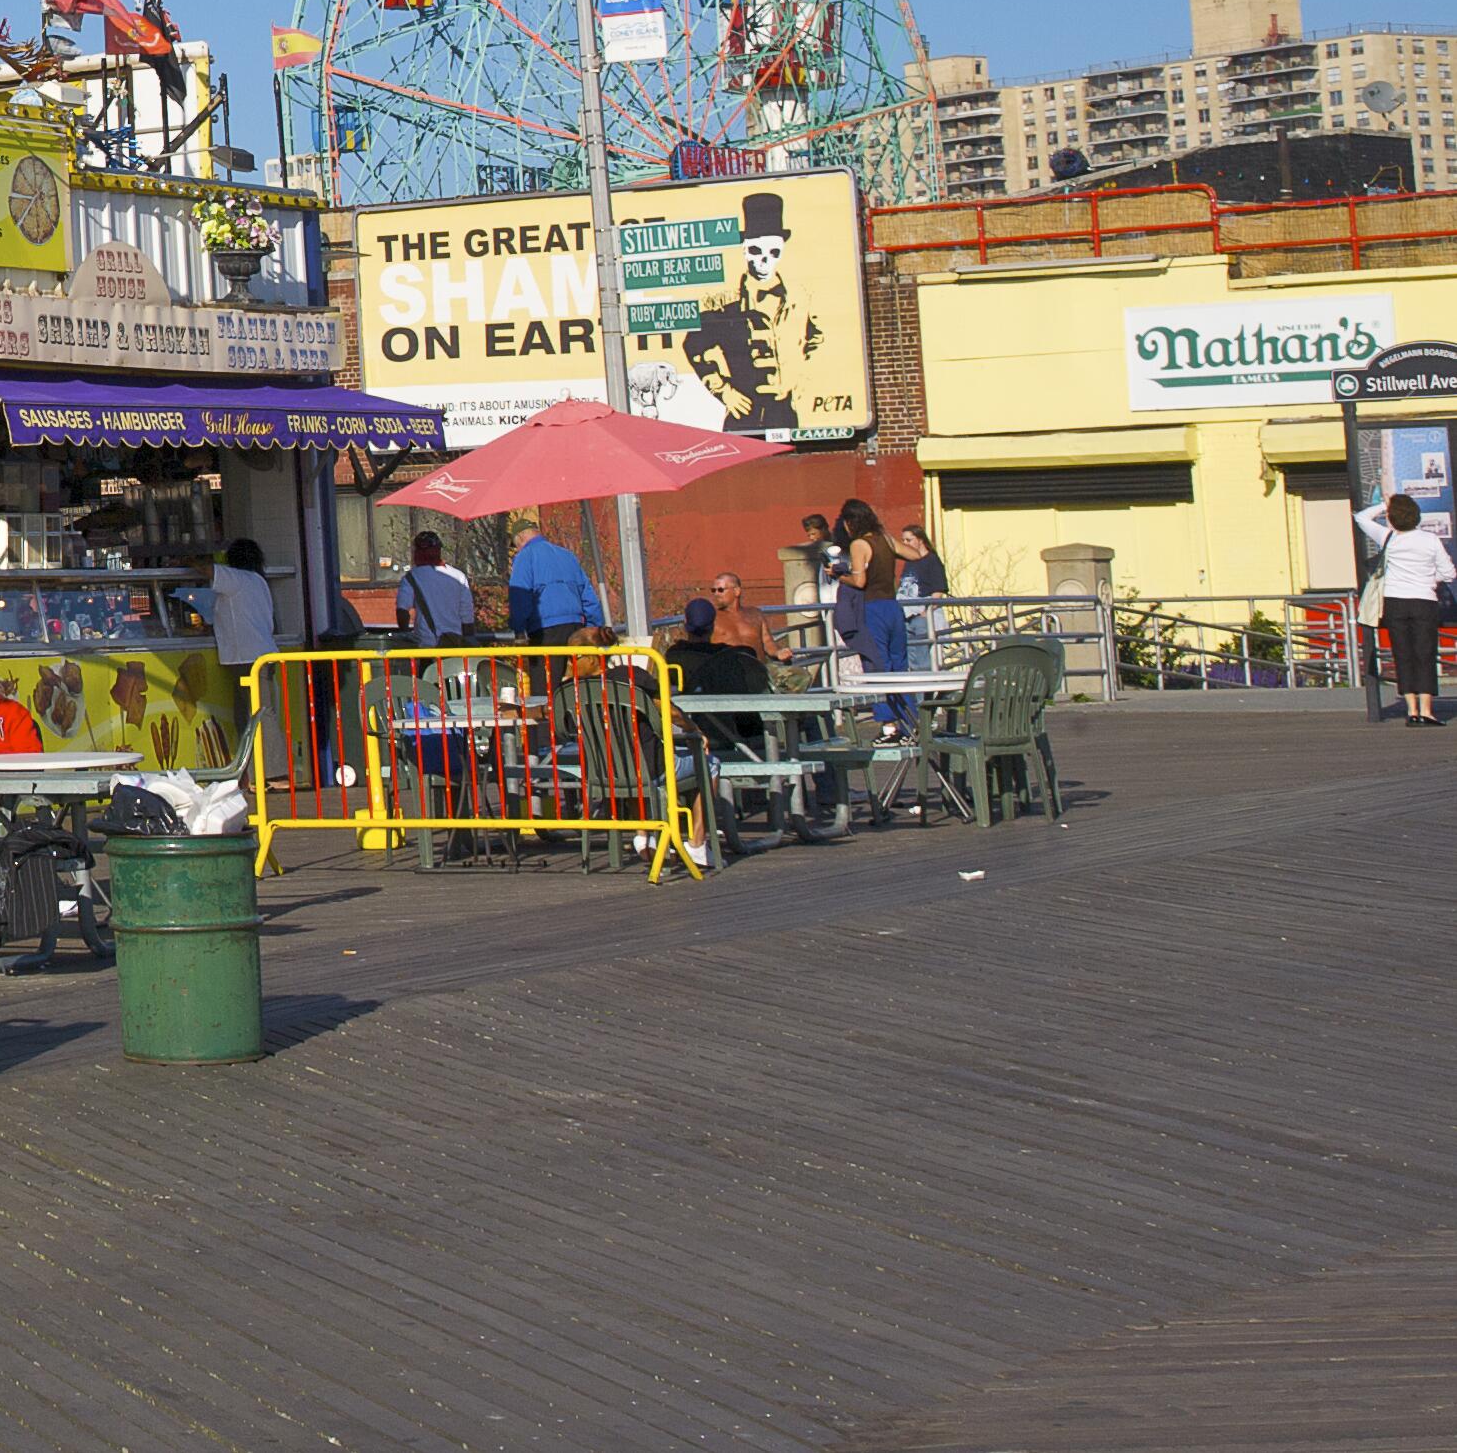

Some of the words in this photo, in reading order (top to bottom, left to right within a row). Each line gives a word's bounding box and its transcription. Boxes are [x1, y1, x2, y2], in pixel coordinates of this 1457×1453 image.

[377, 233, 454, 262] THE
[624, 223, 710, 254] STILLWELL
[716, 221, 732, 234] AV
[625, 261, 659, 278] POLAR
[663, 259, 690, 275] BEAR
[695, 256, 722, 272] CLUB
[662, 275, 687, 285] WALK
[630, 305, 655, 323] RUBY
[659, 303, 698, 320] JACOBS
[654, 320, 675, 329] WALK
[381, 324, 461, 363] ON
[1135, 317, 1384, 370] Nathan's
[1366, 375, 1427, 392] Stillwell
[1430, 376, 1457, 389] Ave
[19, 409, 93, 430] SAUSAGES
[103, 412, 185, 432] HAMBURGER
[794, 428, 851, 439] LAMAR
